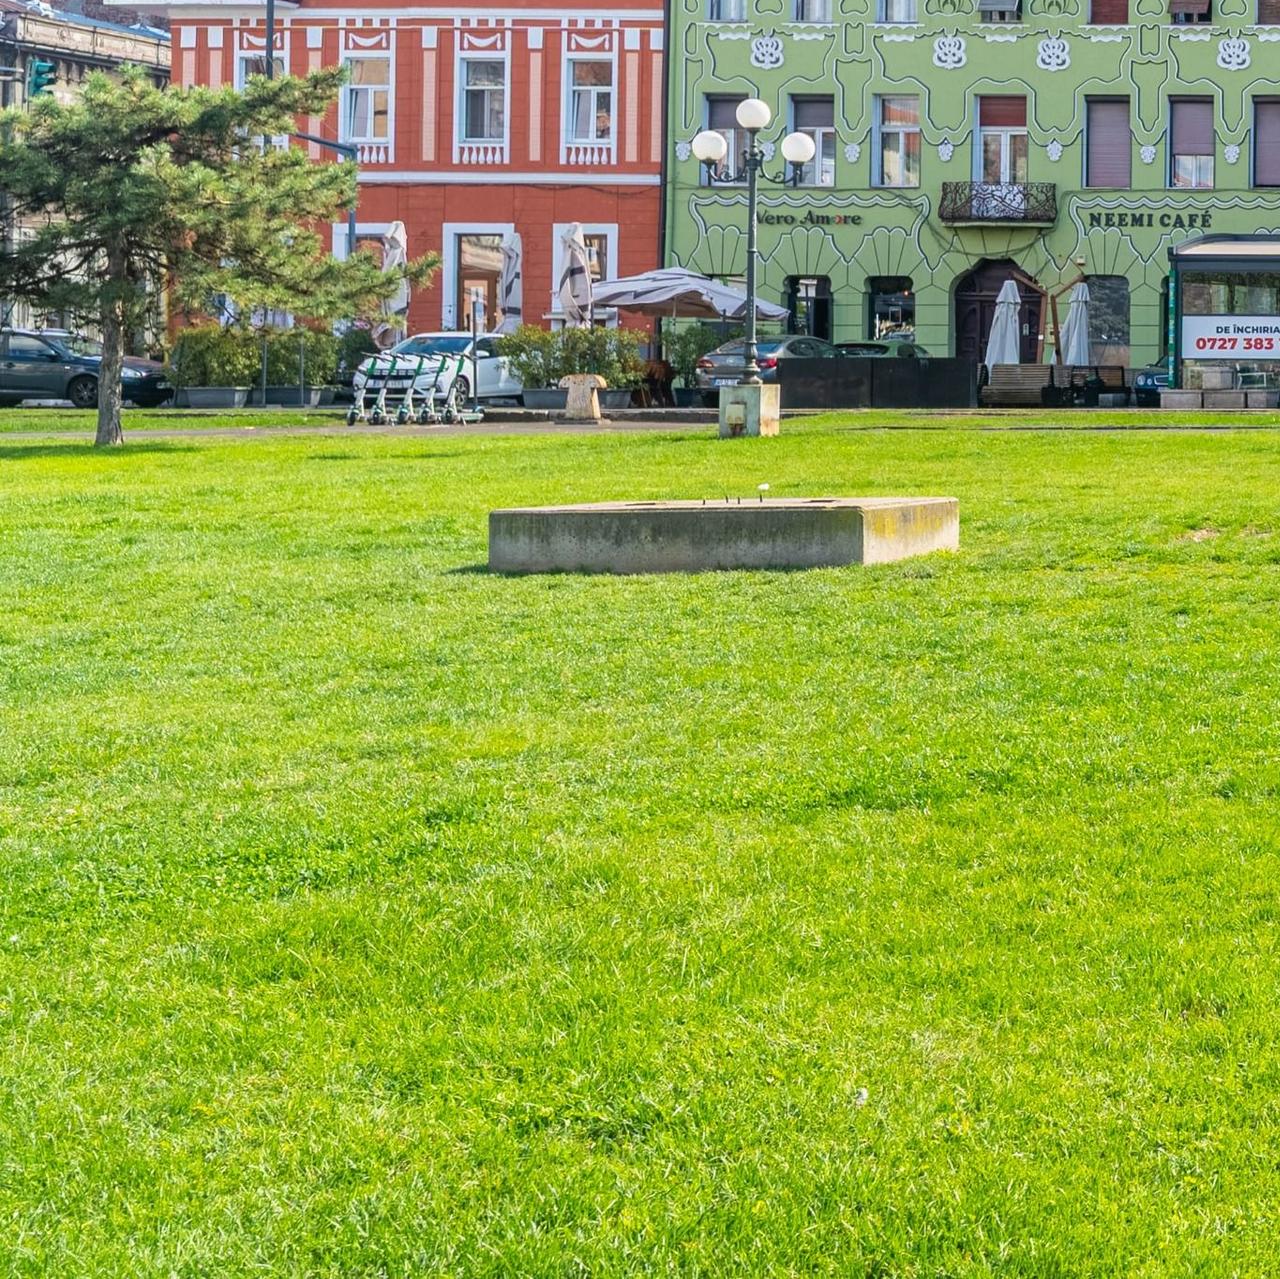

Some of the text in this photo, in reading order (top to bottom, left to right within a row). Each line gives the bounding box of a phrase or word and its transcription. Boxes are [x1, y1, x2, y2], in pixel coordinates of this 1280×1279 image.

[756, 210, 862, 225] Vero Amore
[1089, 211, 1212, 228] NEEMI CAFÉ
[1216, 326, 1230, 334] DE
[1195, 338, 1238, 350] 0727
[1243, 338, 1274, 350] 383
